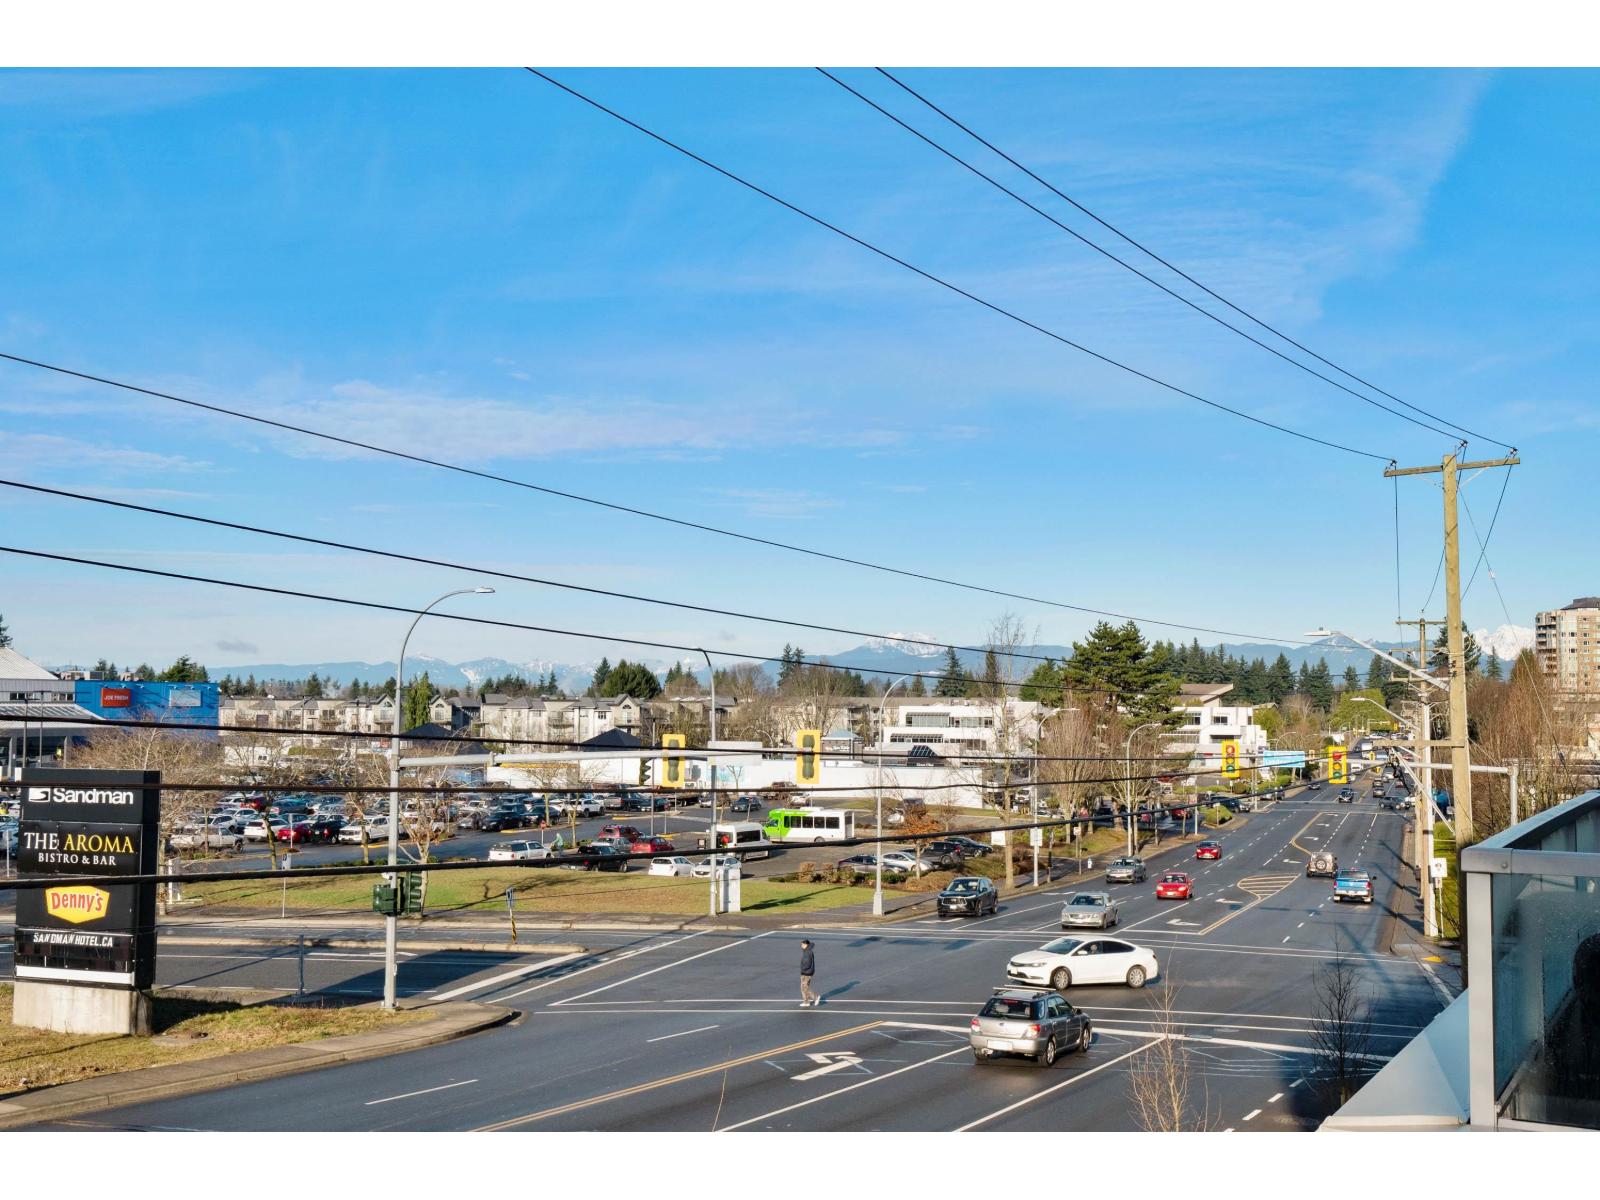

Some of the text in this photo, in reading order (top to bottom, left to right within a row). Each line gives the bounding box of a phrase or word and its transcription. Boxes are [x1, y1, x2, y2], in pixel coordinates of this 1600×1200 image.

[53, 788, 134, 804] Sandman
[24, 832, 134, 853] THE AROMA
[38, 853, 117, 866] BISTRO & BAR
[51, 892, 104, 912] Denny's
